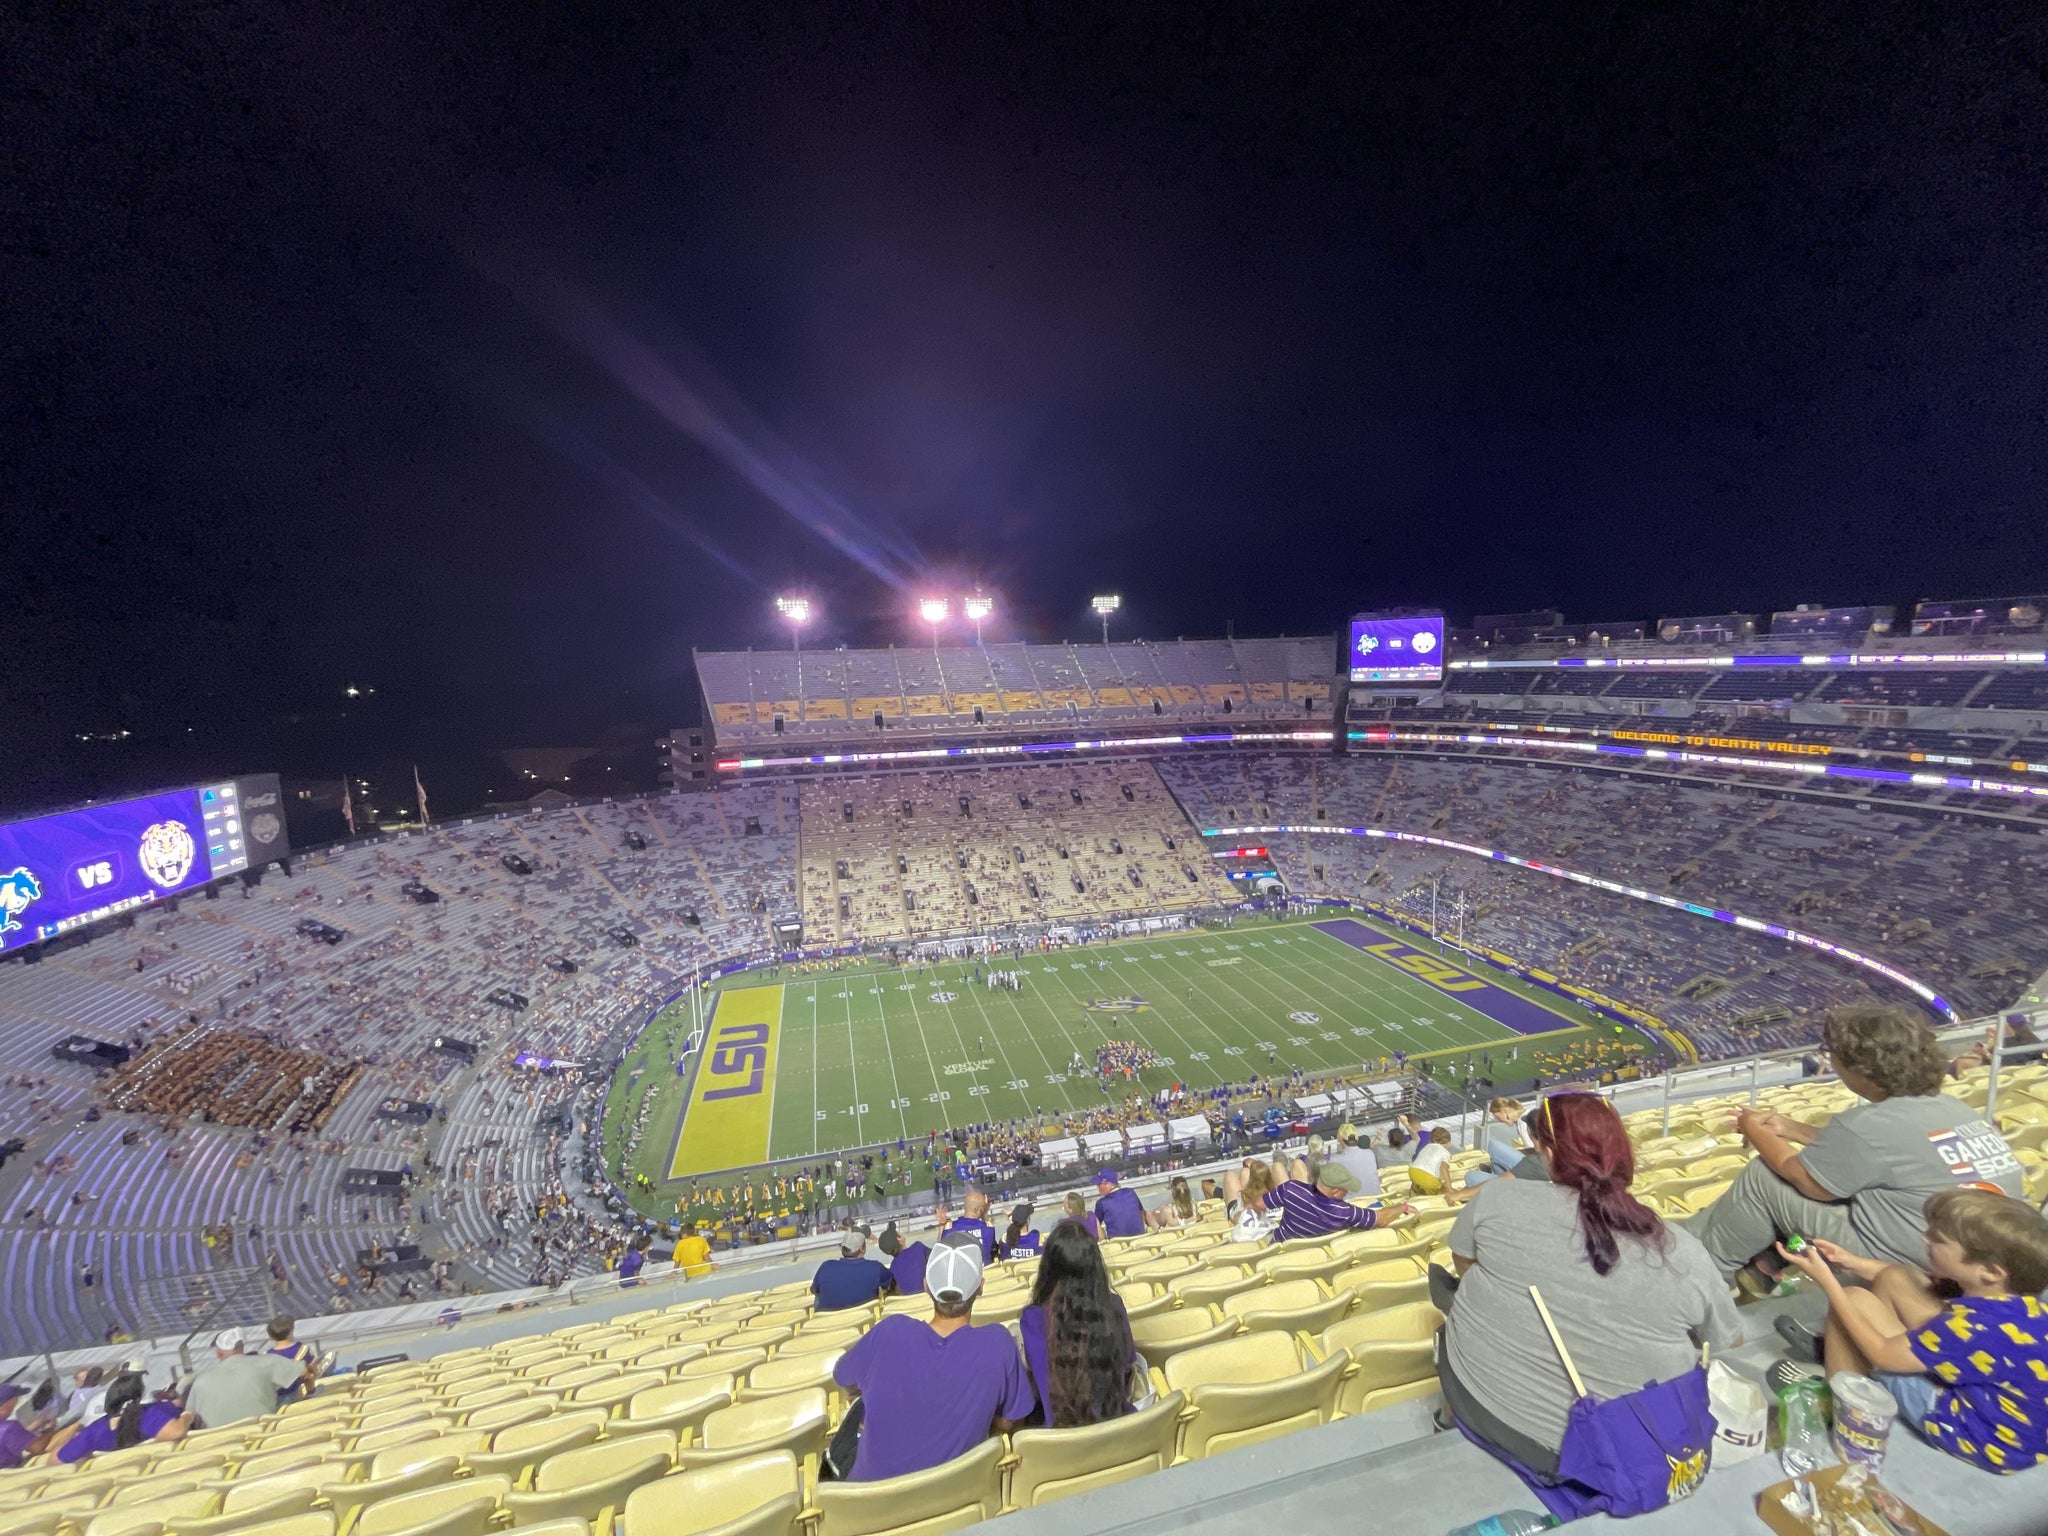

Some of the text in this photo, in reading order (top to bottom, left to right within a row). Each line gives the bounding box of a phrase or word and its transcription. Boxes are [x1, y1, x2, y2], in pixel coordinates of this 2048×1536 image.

[1613, 730, 1680, 744] WELCOME
[1686, 735, 1704, 746] TO
[1708, 737, 1761, 751] DEATH
[1767, 741, 1832, 756] VALLEY
[77, 861, 113, 889] VS
[1362, 942, 1488, 992] LSU
[929, 991, 958, 1003] SEC
[1255, 1041, 1277, 1051] 35
[1155, 1057, 1176, 1067] 50
[1190, 1052, 1210, 1061] 45
[703, 1023, 770, 1102] LSU
[943, 1058, 996, 1069] VENTURE
[944, 1064, 990, 1075] GLOBAL
[1044, 1073, 1067, 1084] 35
[1006, 1079, 1029, 1090] 30
[968, 1085, 990, 1096] 25
[928, 1091, 951, 1103] 20
[890, 1097, 910, 1109] 15
[848, 1103, 869, 1115] 10
[816, 1110, 827, 1120] 5
[1010, 1248, 1034, 1257] HESTER
[1713, 1428, 1763, 1447] SU
